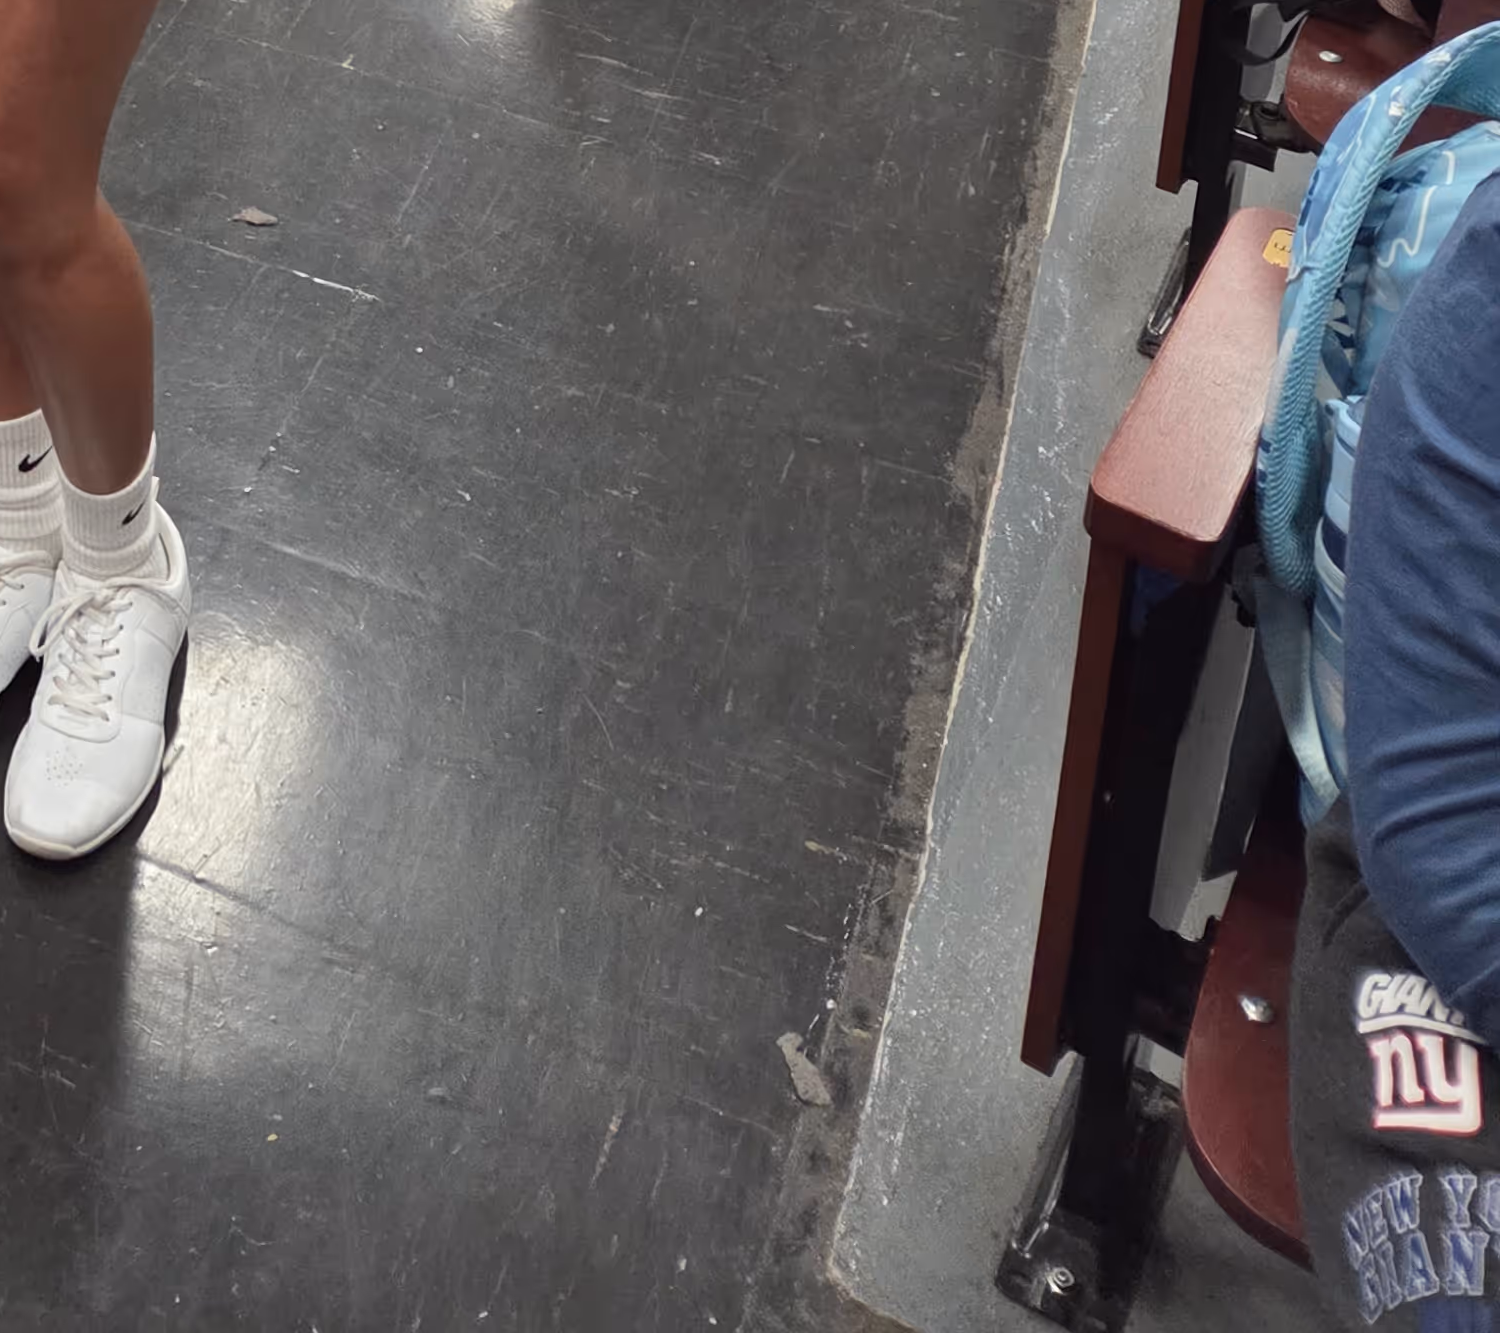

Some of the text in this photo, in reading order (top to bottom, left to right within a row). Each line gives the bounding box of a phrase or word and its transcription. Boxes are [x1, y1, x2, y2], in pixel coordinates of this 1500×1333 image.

[1358, 973, 1466, 1020] GIAN
[1343, 1173, 1424, 1271] NEW
[1357, 1228, 1500, 1326] GIAN
